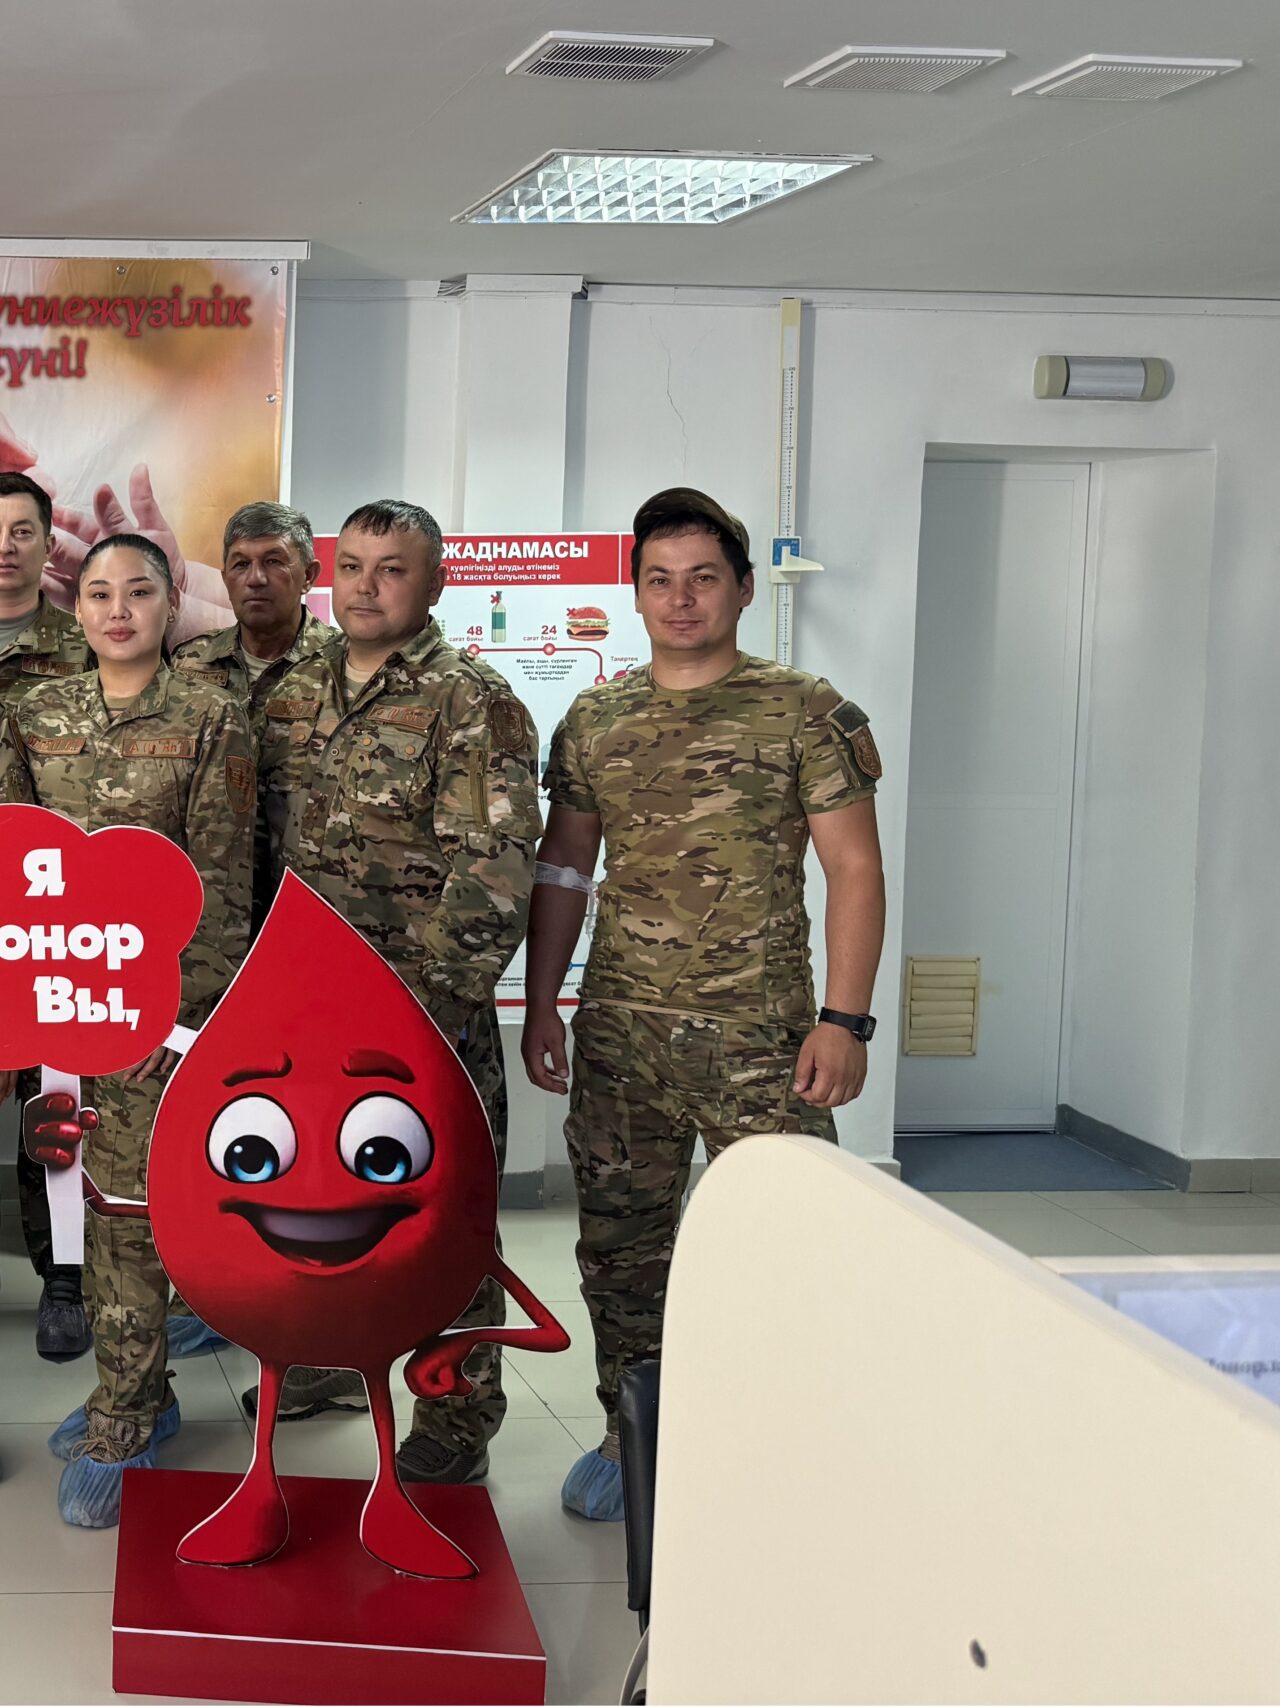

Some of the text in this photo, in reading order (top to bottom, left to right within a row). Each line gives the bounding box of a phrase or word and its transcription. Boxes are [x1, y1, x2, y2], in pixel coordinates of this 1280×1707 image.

[498, 564, 524, 572] алуды
[538, 573, 561, 581] керек
[467, 626, 483, 636] 48
[541, 625, 557, 635] 24
[22, 848, 66, 898] Я
[33, 975, 141, 1032] Вы,
